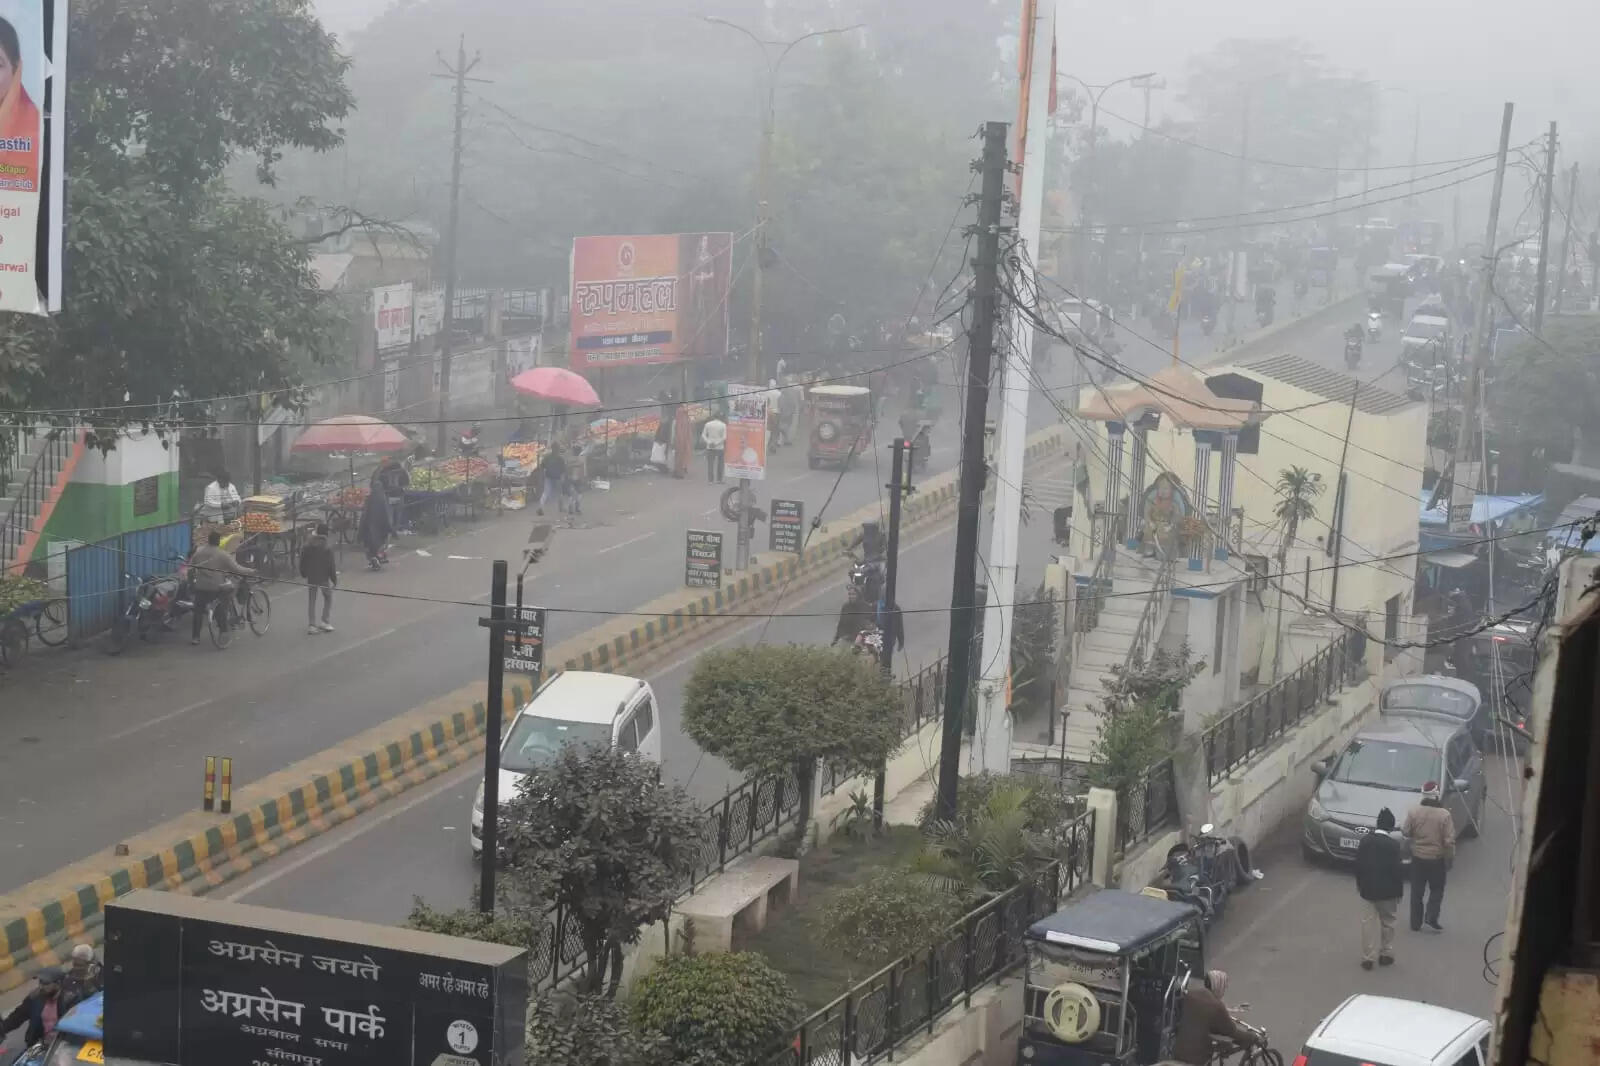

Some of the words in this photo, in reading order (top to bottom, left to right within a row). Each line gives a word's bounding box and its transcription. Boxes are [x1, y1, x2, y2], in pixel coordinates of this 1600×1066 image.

[208, 940, 304, 968] अग्रसेन
[312, 954, 382, 980] जयते
[420, 972, 441, 991] अमर
[442, 971, 455, 993] रहे
[455, 978, 476, 997] अमर
[477, 977, 489, 999] रहे
[200, 986, 305, 1027] अग्रसेन
[320, 1004, 386, 1040] पार्क
